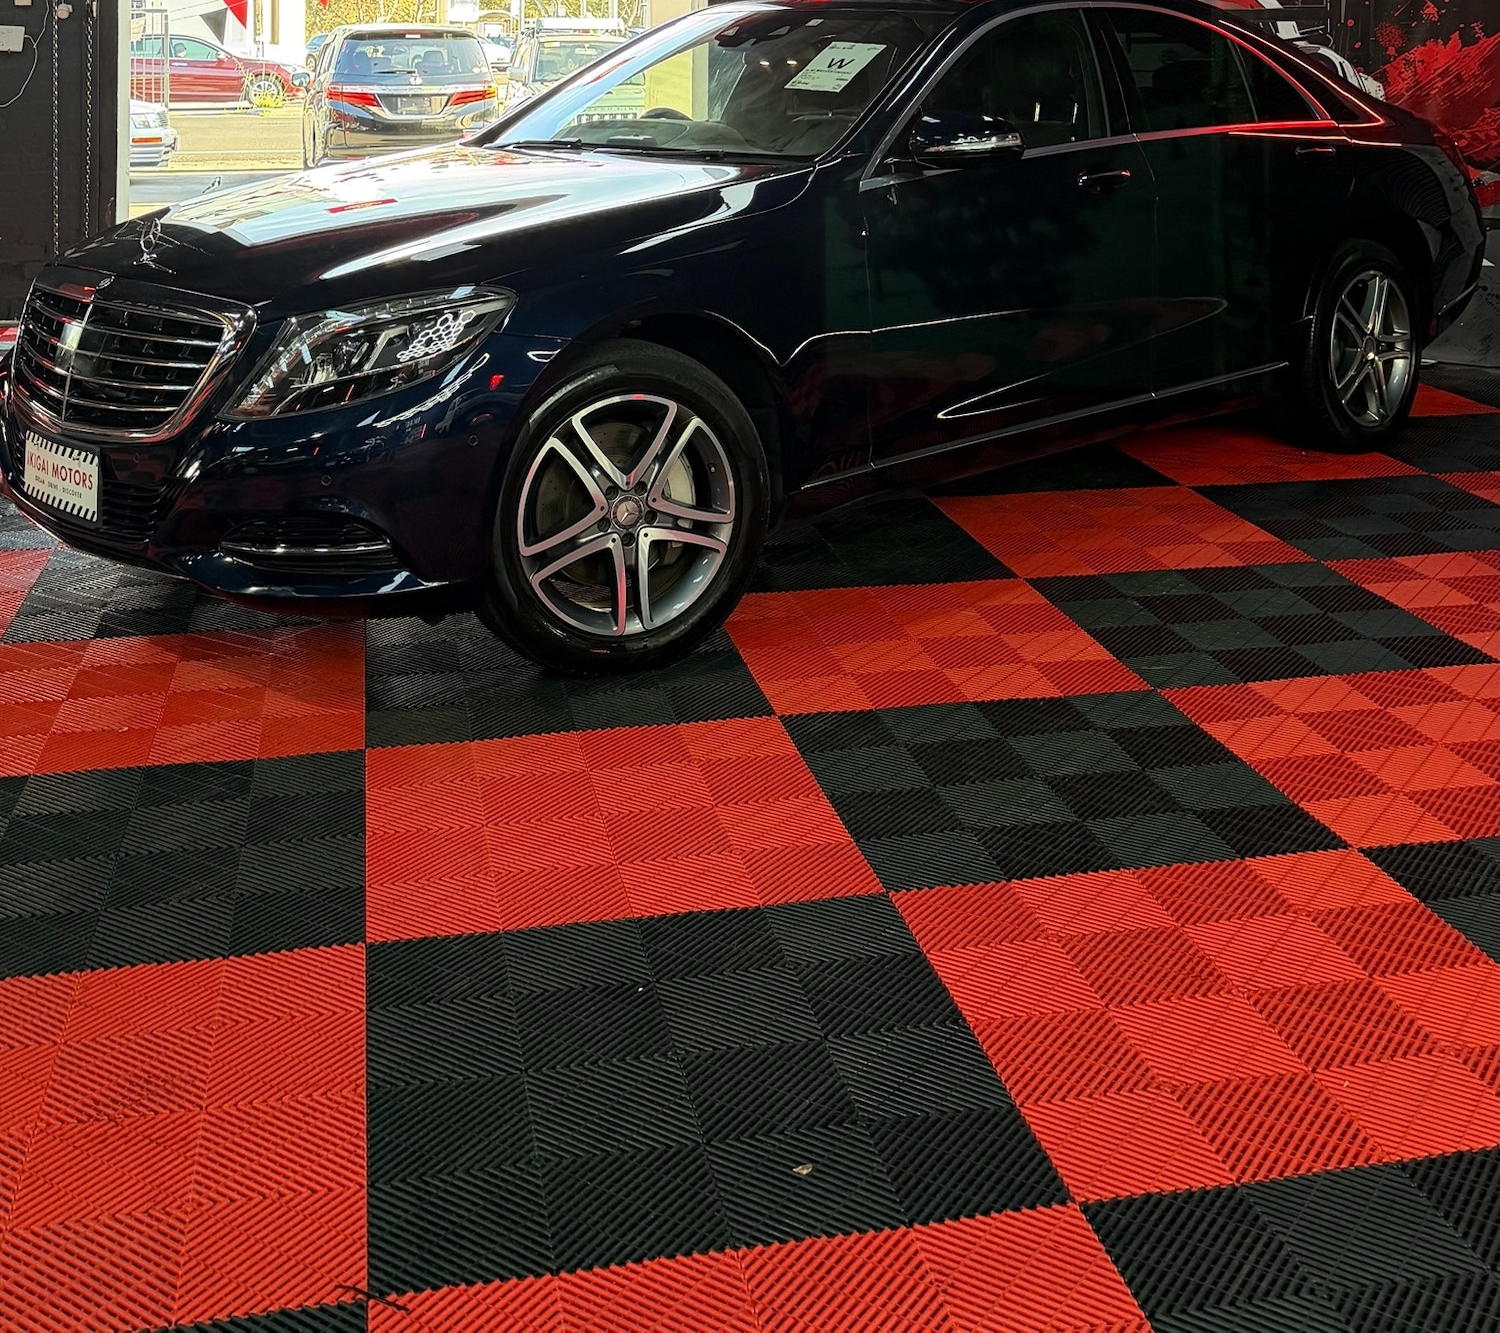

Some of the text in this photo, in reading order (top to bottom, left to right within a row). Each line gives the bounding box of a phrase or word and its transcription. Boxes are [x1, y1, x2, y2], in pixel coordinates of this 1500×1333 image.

[827, 58, 855, 69] W
[27, 450, 93, 490] IKIGAI MOTORS
